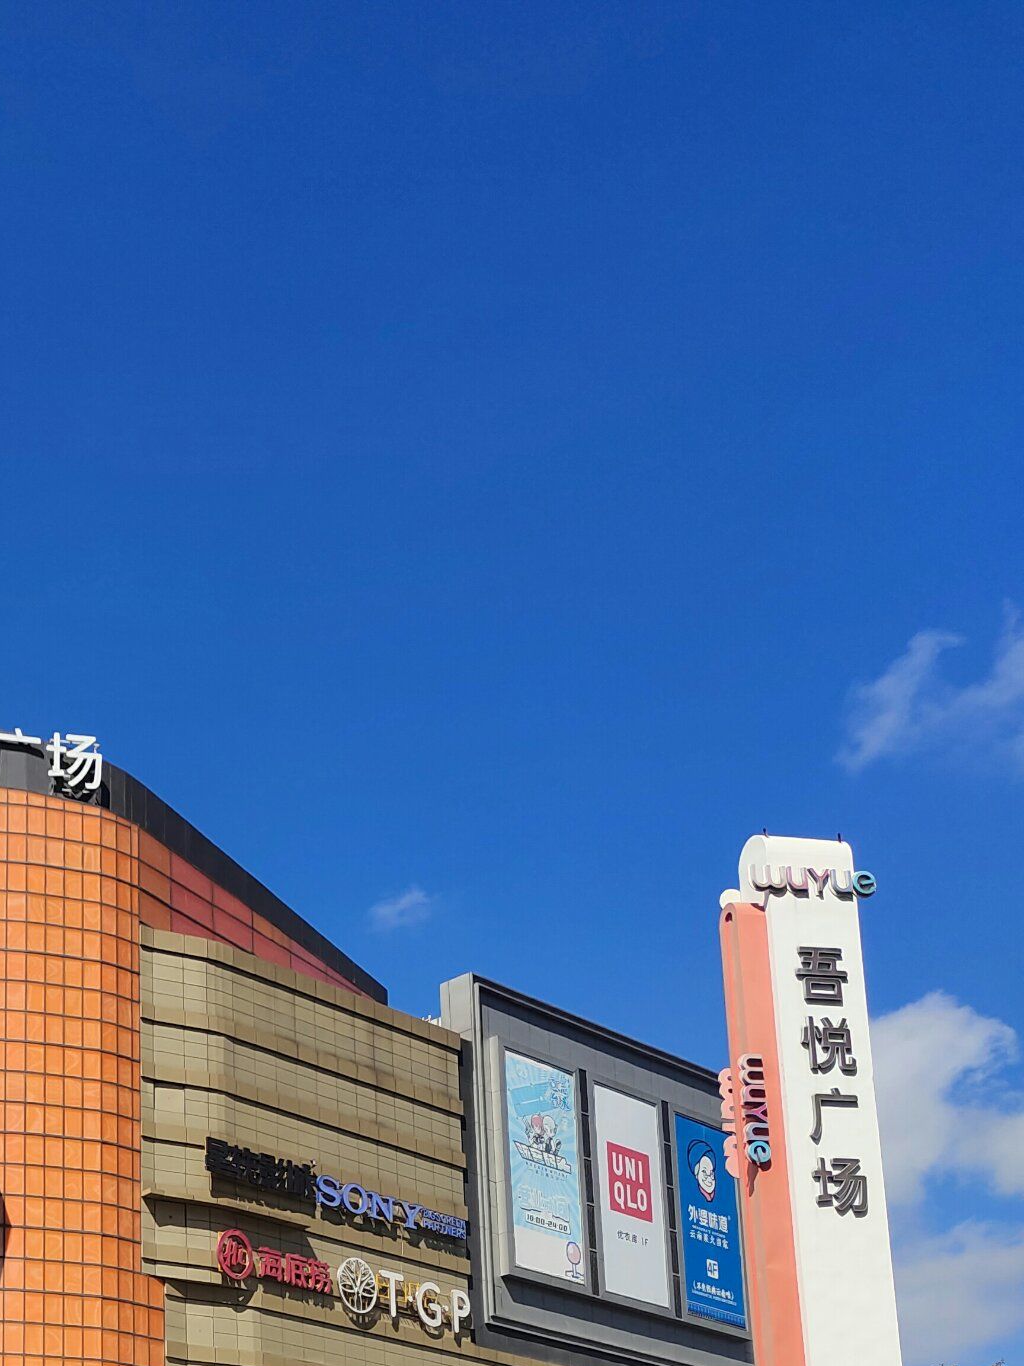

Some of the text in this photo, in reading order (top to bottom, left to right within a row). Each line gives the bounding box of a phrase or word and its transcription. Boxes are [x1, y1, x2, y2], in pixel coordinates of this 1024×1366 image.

[795, 946, 868, 1217] 吾悦广场
[612, 1152, 643, 1183] UNI
[316, 1174, 423, 1230] SONY
[613, 1181, 647, 1212] QLO
